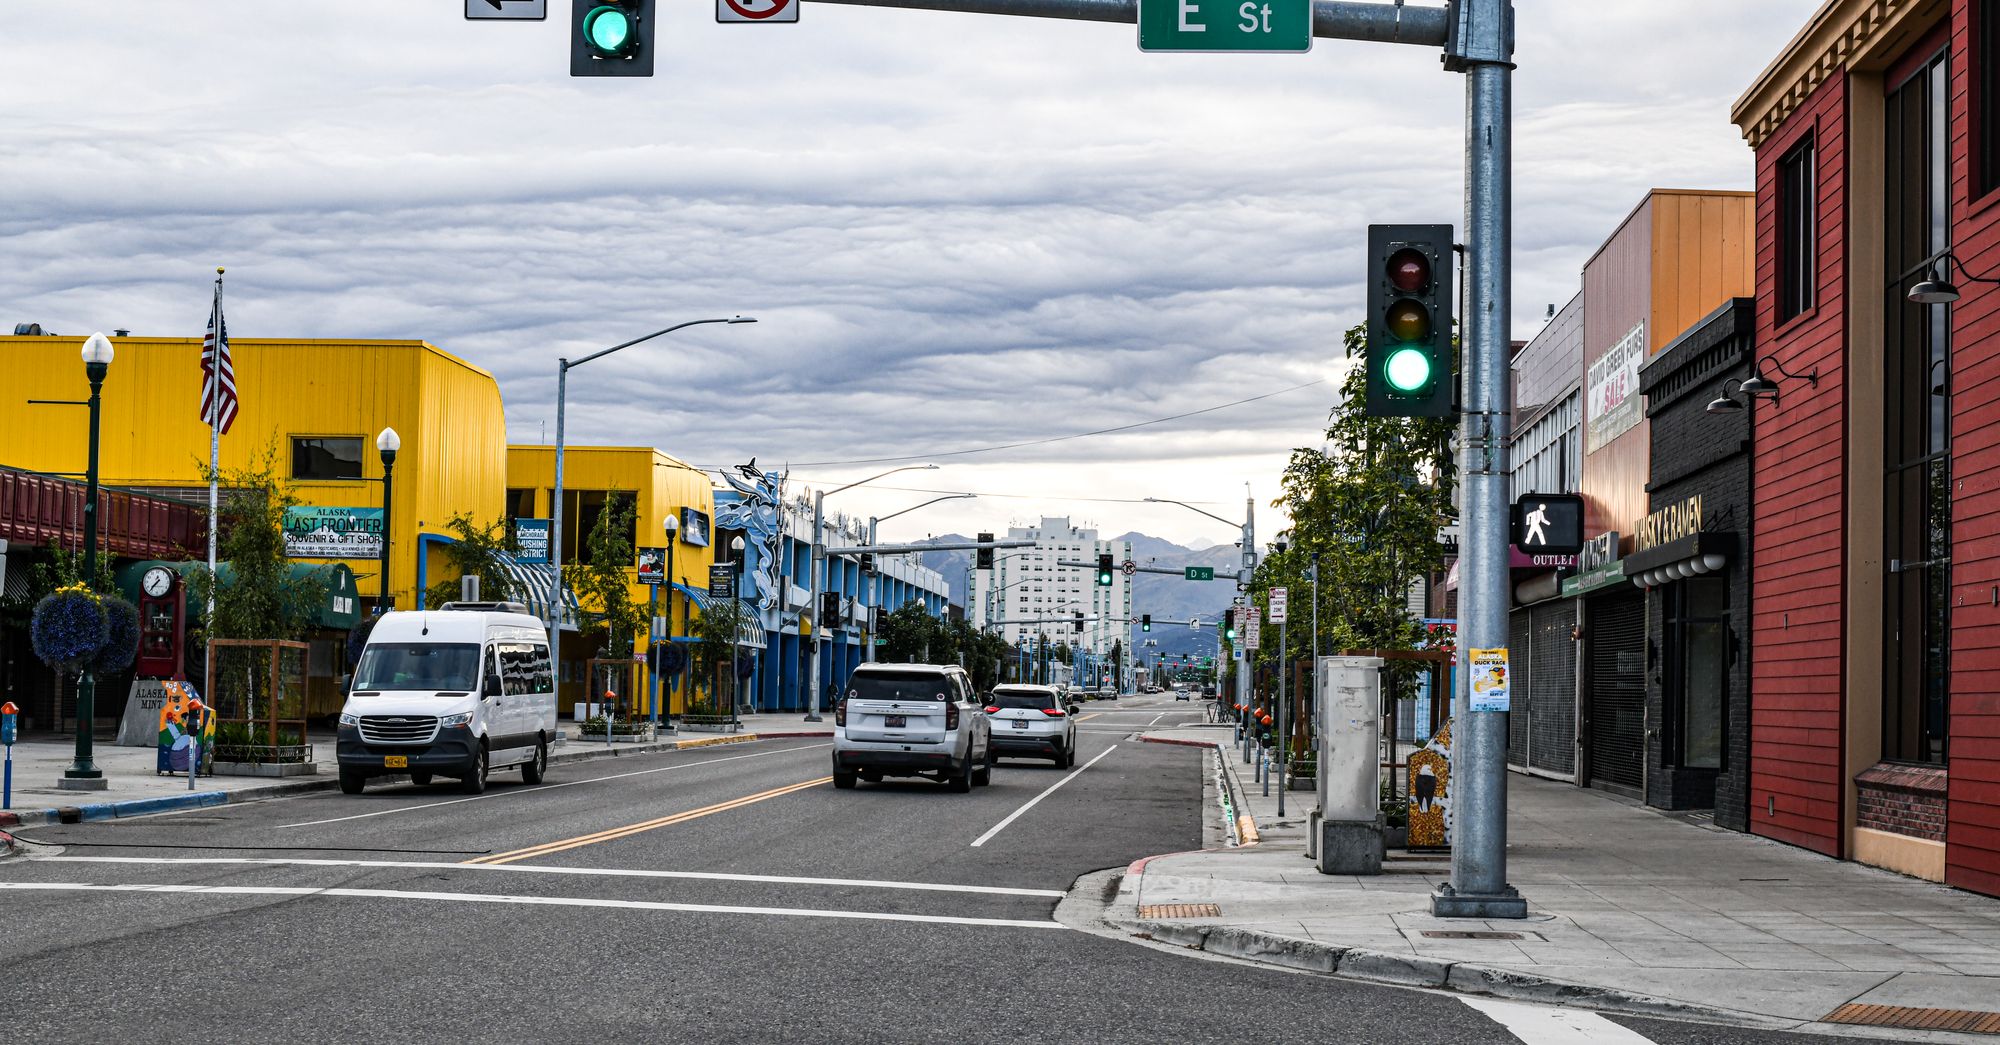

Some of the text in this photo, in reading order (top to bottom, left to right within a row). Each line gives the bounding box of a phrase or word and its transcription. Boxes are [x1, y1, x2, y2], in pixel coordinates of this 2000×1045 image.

[1178, 0, 1272, 33] E St
[1589, 328, 1642, 391] DAVID GREEN FURS
[1604, 371, 1625, 415] SALE
[316, 508, 352, 516] ALASKA
[286, 517, 381, 533] LAST FRONTIER
[1634, 509, 1663, 553] WHISKY
[1663, 506, 1670, 544] &
[1670, 494, 1702, 542] RAMEN
[286, 534, 380, 544] SOUVENIR & GIFT SHOP
[518, 540, 546, 548] MUSHING
[1533, 554, 1574, 566] OUTLET
[1190, 570, 1197, 578] D
[136, 689, 168, 698] ALASKA
[141, 700, 162, 709] MINT
